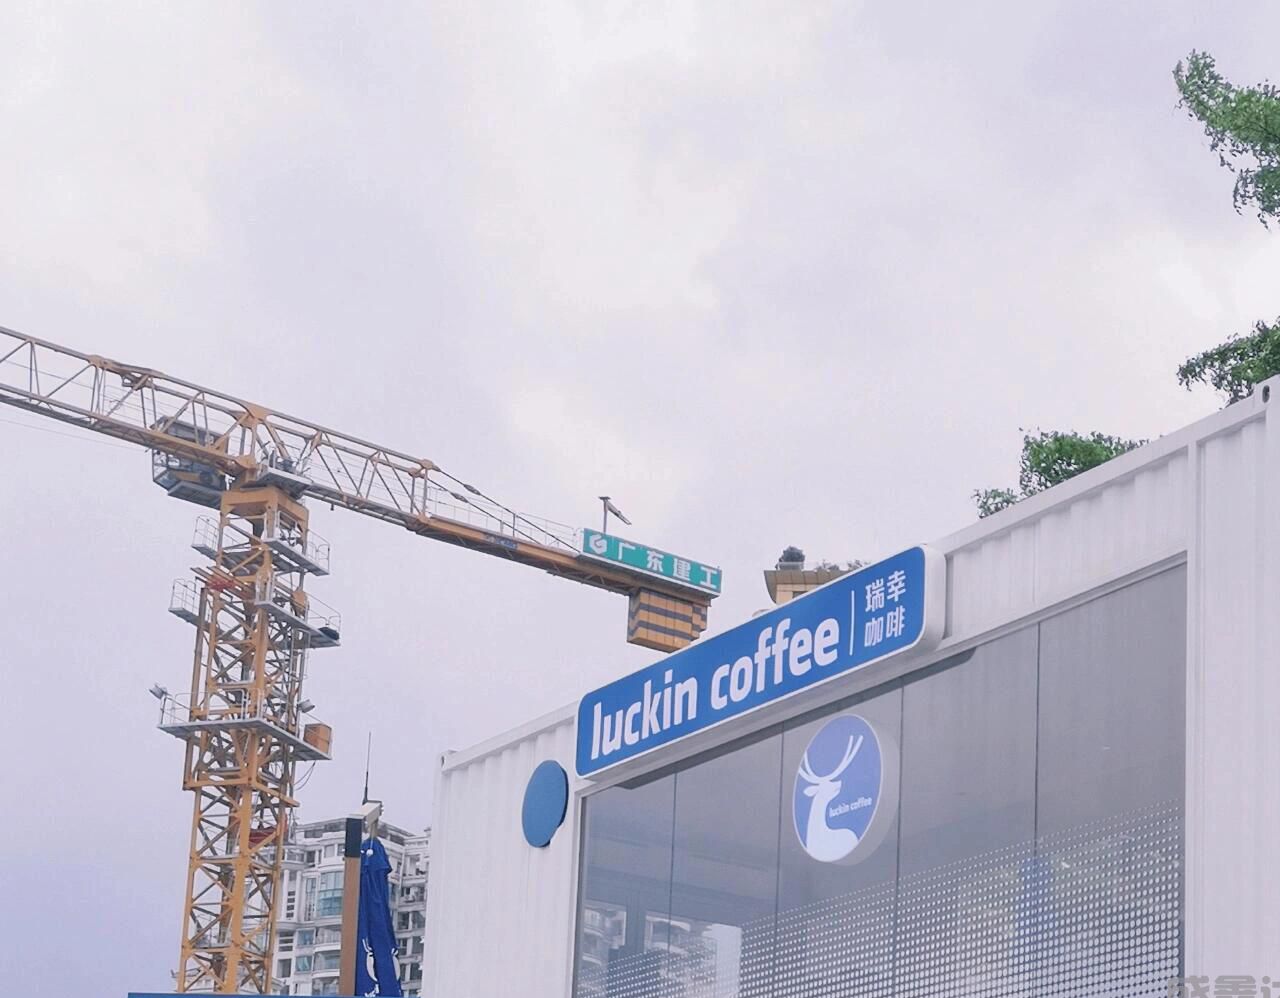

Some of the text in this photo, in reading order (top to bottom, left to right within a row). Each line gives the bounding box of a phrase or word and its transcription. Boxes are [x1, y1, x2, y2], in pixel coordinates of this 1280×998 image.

[618, 542, 718, 588] 广东建工
[864, 570, 906, 613] 瑞幸
[864, 606, 905, 647] 咖啡
[591, 617, 840, 761] luckin coffee
[829, 797, 873, 818] luckin coffee
